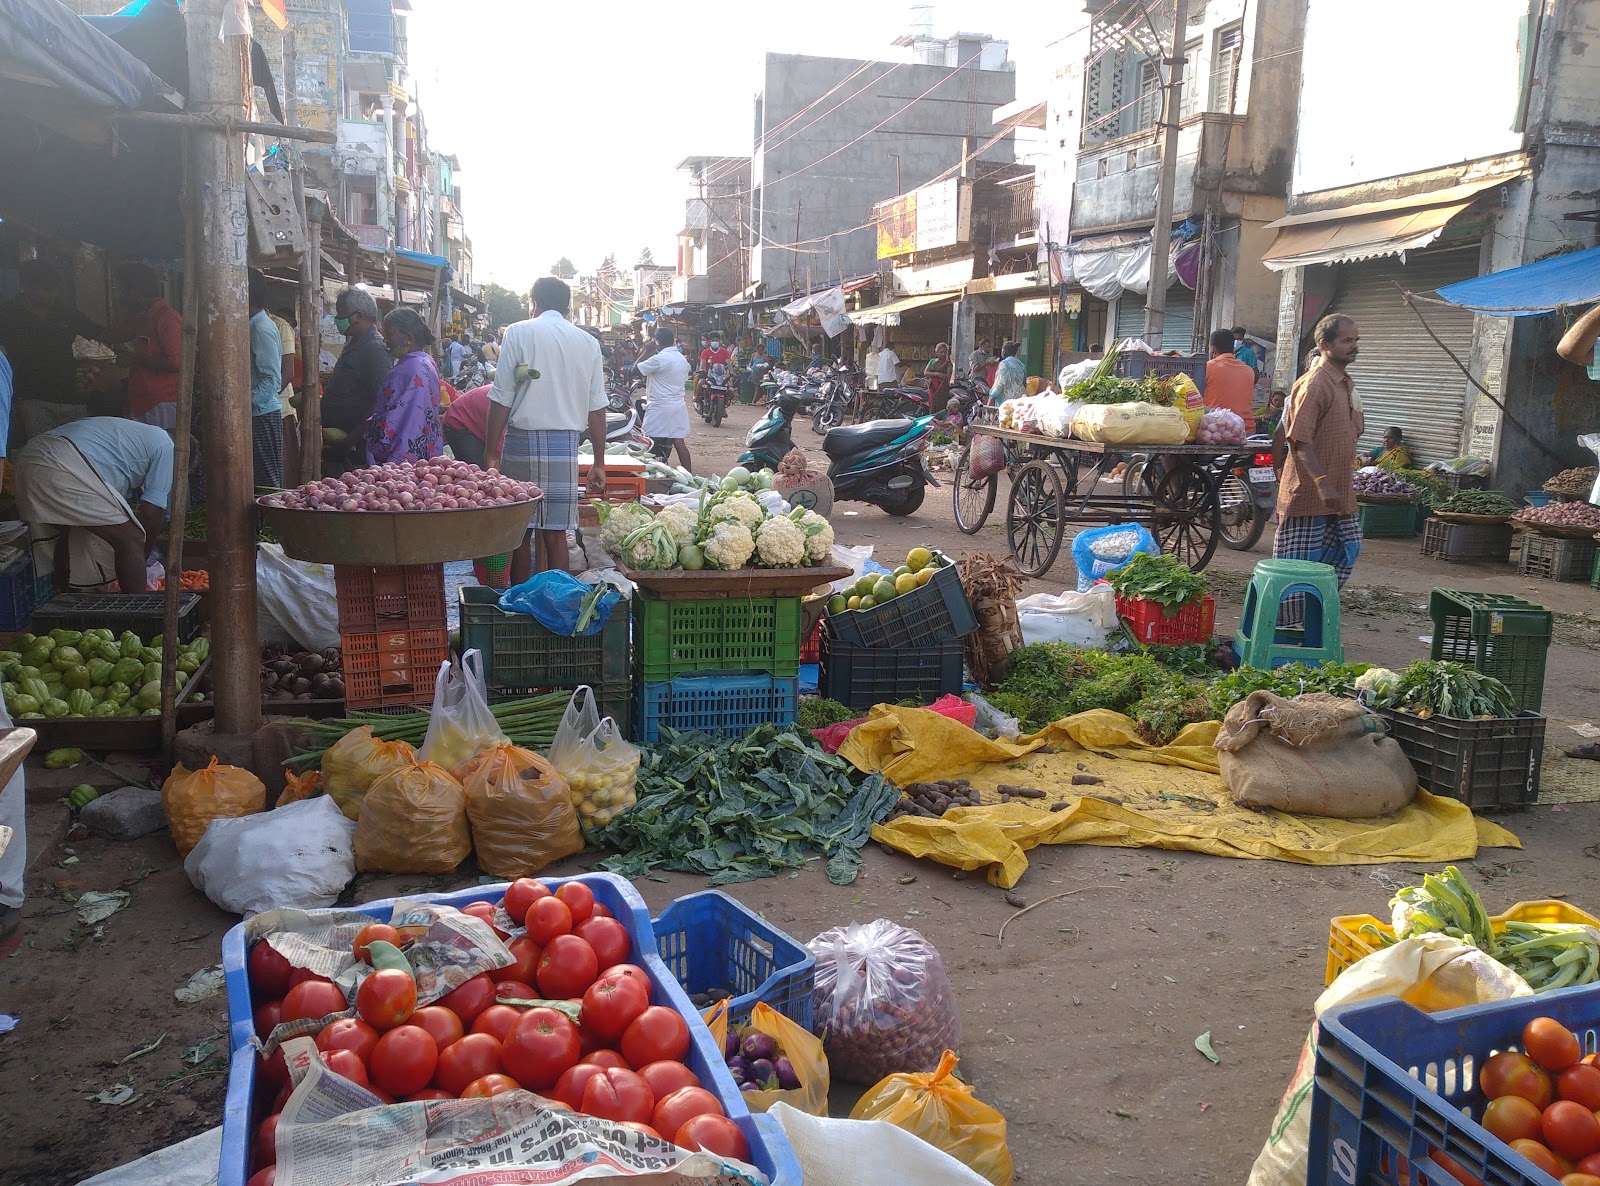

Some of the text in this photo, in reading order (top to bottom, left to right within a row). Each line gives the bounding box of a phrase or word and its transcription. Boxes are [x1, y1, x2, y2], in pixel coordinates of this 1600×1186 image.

[1526, 748, 1535, 792] LFC
[512, 1120, 541, 1140] stretch
[494, 1134, 512, 1147] that
[431, 1148, 465, 1166] ignored
[1332, 1138, 1357, 1185] S
